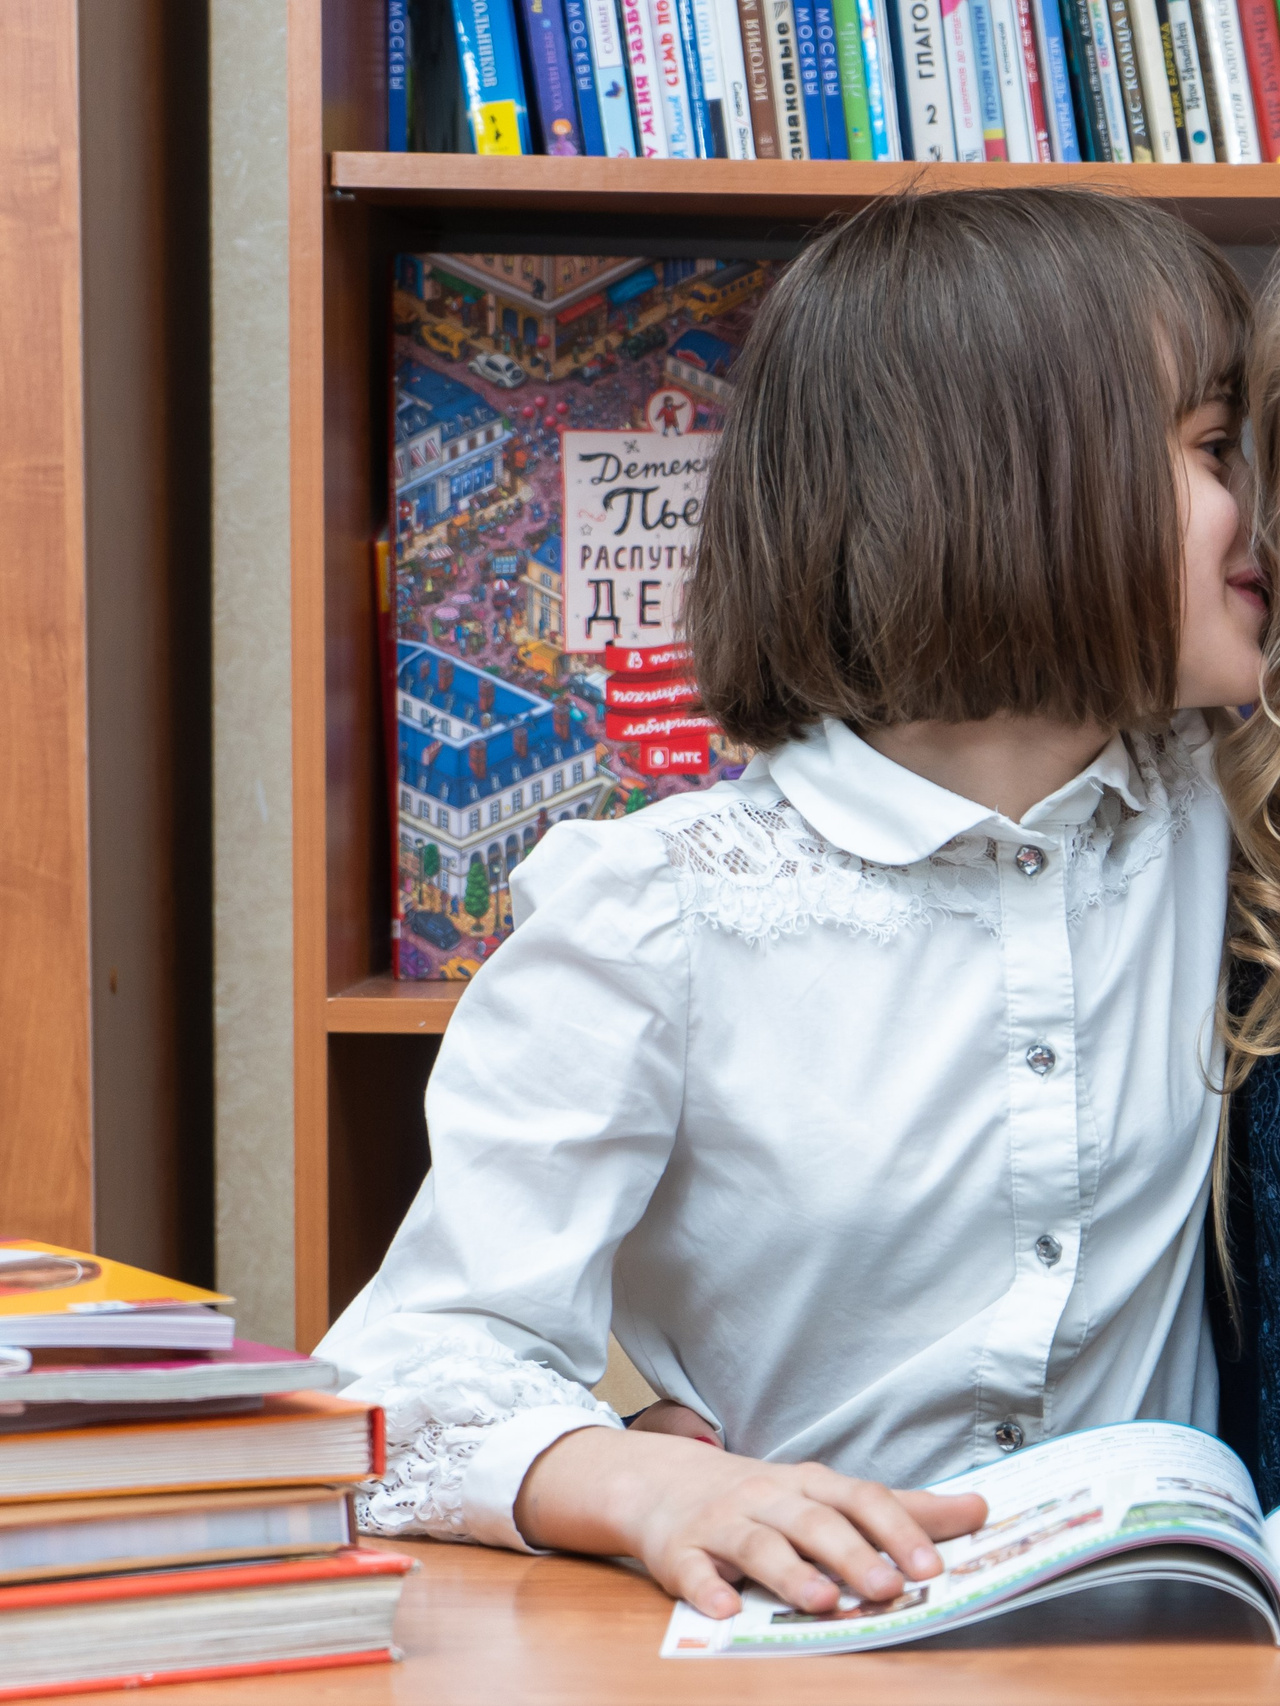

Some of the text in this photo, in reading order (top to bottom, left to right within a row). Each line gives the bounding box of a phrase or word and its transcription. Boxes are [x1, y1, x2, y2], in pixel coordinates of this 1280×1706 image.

[389, 1, 405, 90] МОСКВЫ
[470, 0, 497, 88] ОЛЬНИКОВ
[568, 1, 592, 90] МОСКВЫ
[661, 33, 679, 87] СЕМЬ
[746, 18, 768, 101] ИСТОРИЯ
[797, 7, 819, 96] МОСКВЫ
[816, 7, 839, 96] МОСКВЫ
[1115, 17, 1139, 90] КОЛЬЦА
[926, 105, 938, 124] 2
[1128, 95, 1145, 137] ЛЕС.
[579, 452, 707, 485] Детек
[602, 486, 700, 535] Пье
[585, 578, 672, 639] ДЕ
[628, 651, 643, 668] В
[671, 751, 702, 764] МТС
